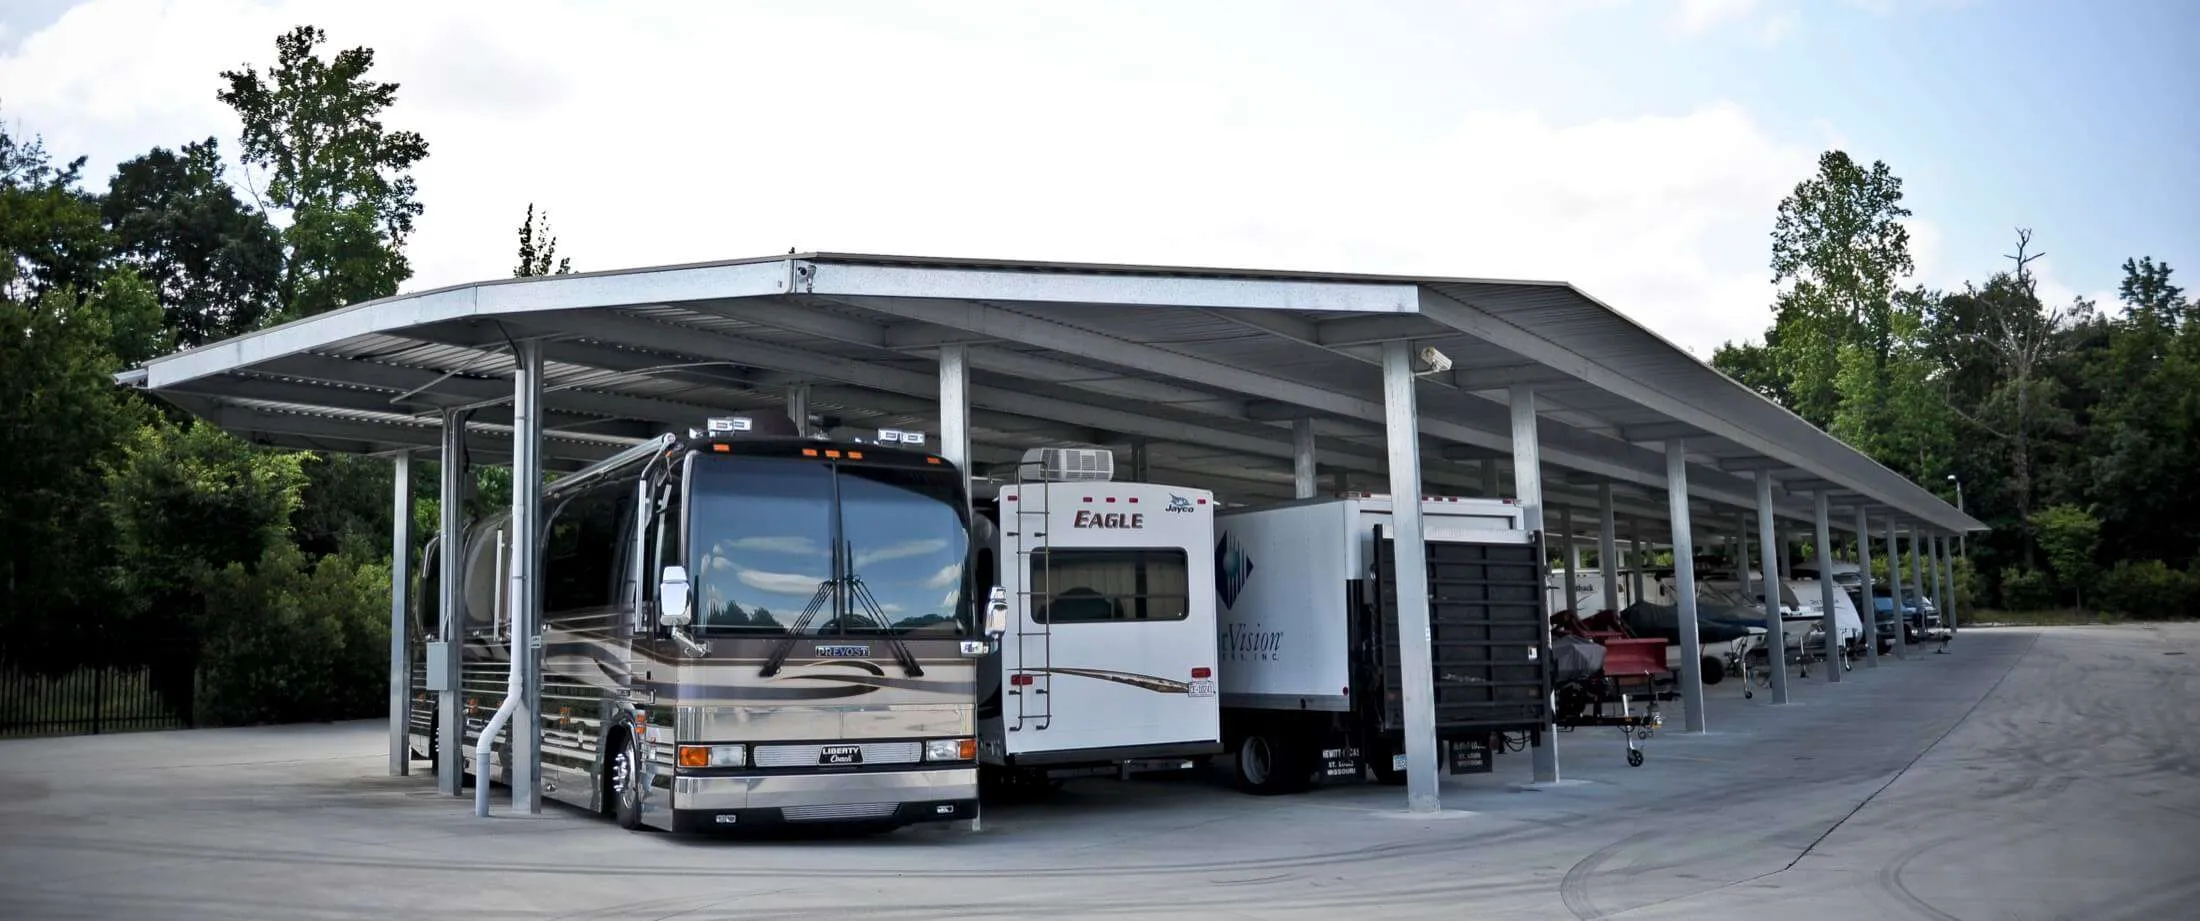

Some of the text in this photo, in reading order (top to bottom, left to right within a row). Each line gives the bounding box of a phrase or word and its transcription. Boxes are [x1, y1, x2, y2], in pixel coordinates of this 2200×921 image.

[1165, 504, 1194, 514] Jayco
[1074, 510, 1144, 529] EAGLE
[818, 647, 869, 657] PREVOST
[822, 747, 859, 755] LIBERTY
